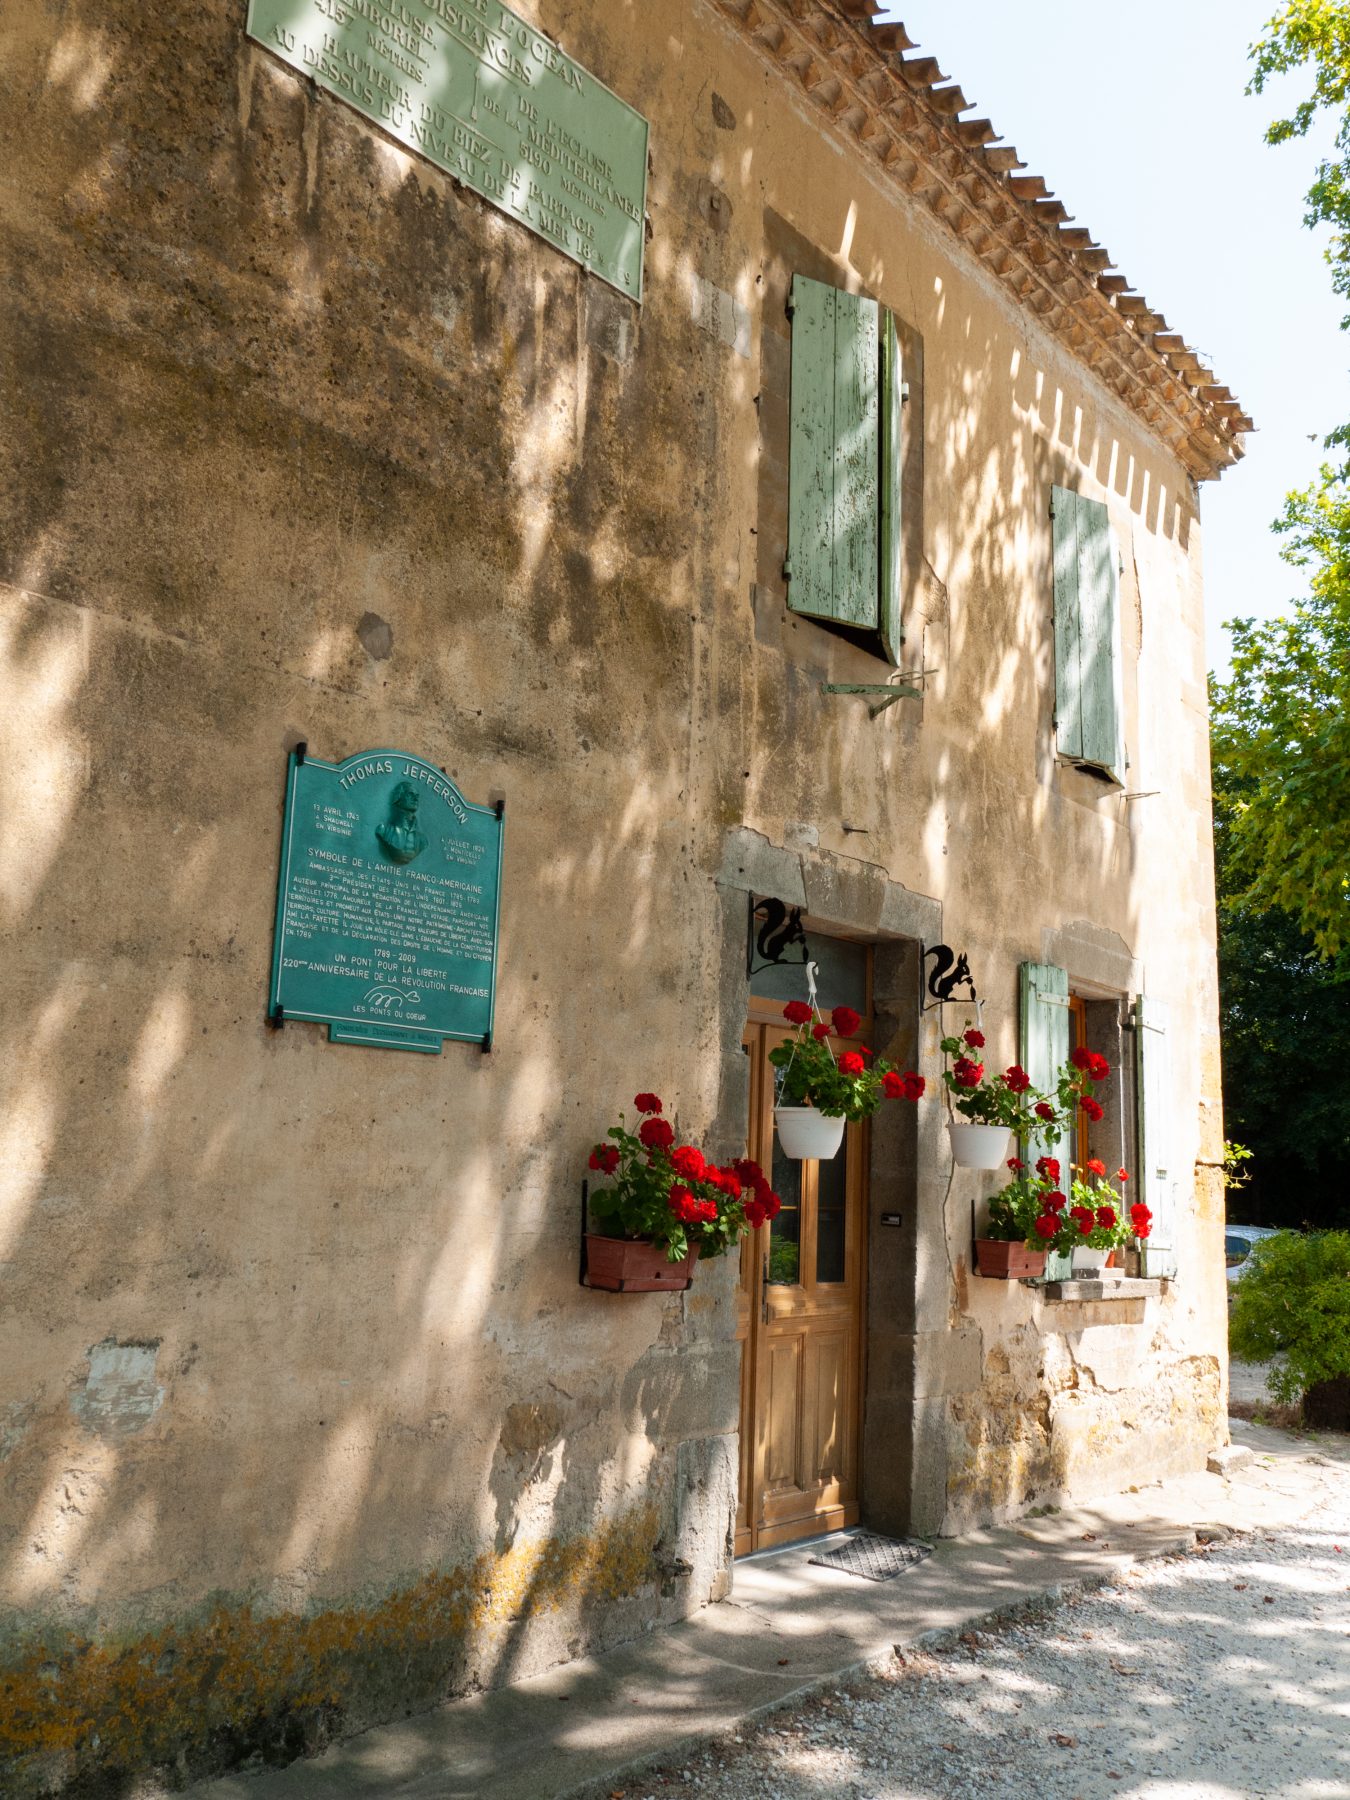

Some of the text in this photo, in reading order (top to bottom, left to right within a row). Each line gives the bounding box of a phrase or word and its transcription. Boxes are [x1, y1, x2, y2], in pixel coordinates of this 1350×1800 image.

[483, 92, 500, 117] DE
[505, 109, 521, 134] LA
[518, 95, 538, 125] DE
[269, 21, 295, 56] AU
[301, 44, 374, 111] DESSUS
[380, 98, 403, 131] DU
[409, 119, 477, 183] NIVEAU
[483, 170, 505, 202] DE
[510, 189, 534, 222] LA
[538, 209, 570, 247] MER
[323, 32, 595, 242] HAUTEUR DU BIEZ DE PARTAGE
[519, 139, 552, 179] 5190
[340, 760, 468, 824] THOMAS JEFFERSON
[323, 805, 342, 816] AVRIL
[346, 811, 359, 821] 1743
[307, 847, 347, 864] SYMBOLE
[352, 857, 363, 867] DE
[309, 861, 353, 877] AMBASSADEUR
[357, 871, 368, 880] DES
[293, 875, 317, 886] AUTEUR
[320, 881, 349, 893] PRINCIPAL
[378, 884, 388, 893] DES
[298, 885, 320, 896] JUILLET
[342, 894, 370, 906] AMOUREUX
[286, 909, 297, 918] AMI
[312, 914, 338, 926] FAYETTE
[361, 906, 371, 914] AUX
[334, 953, 346, 963] UN
[351, 956, 372, 967] PONT
[377, 960, 398, 971] POUR
[402, 964, 412, 974] LA
[374, 948, 390, 958] 1789
[398, 952, 416, 963] 2009
[307, 960, 369, 979] ANNIVERSAIRE
[373, 971, 383, 981] DE
[387, 973, 397, 983] LA
[352, 1004, 426, 1021] LES PONTS DU COEUR
